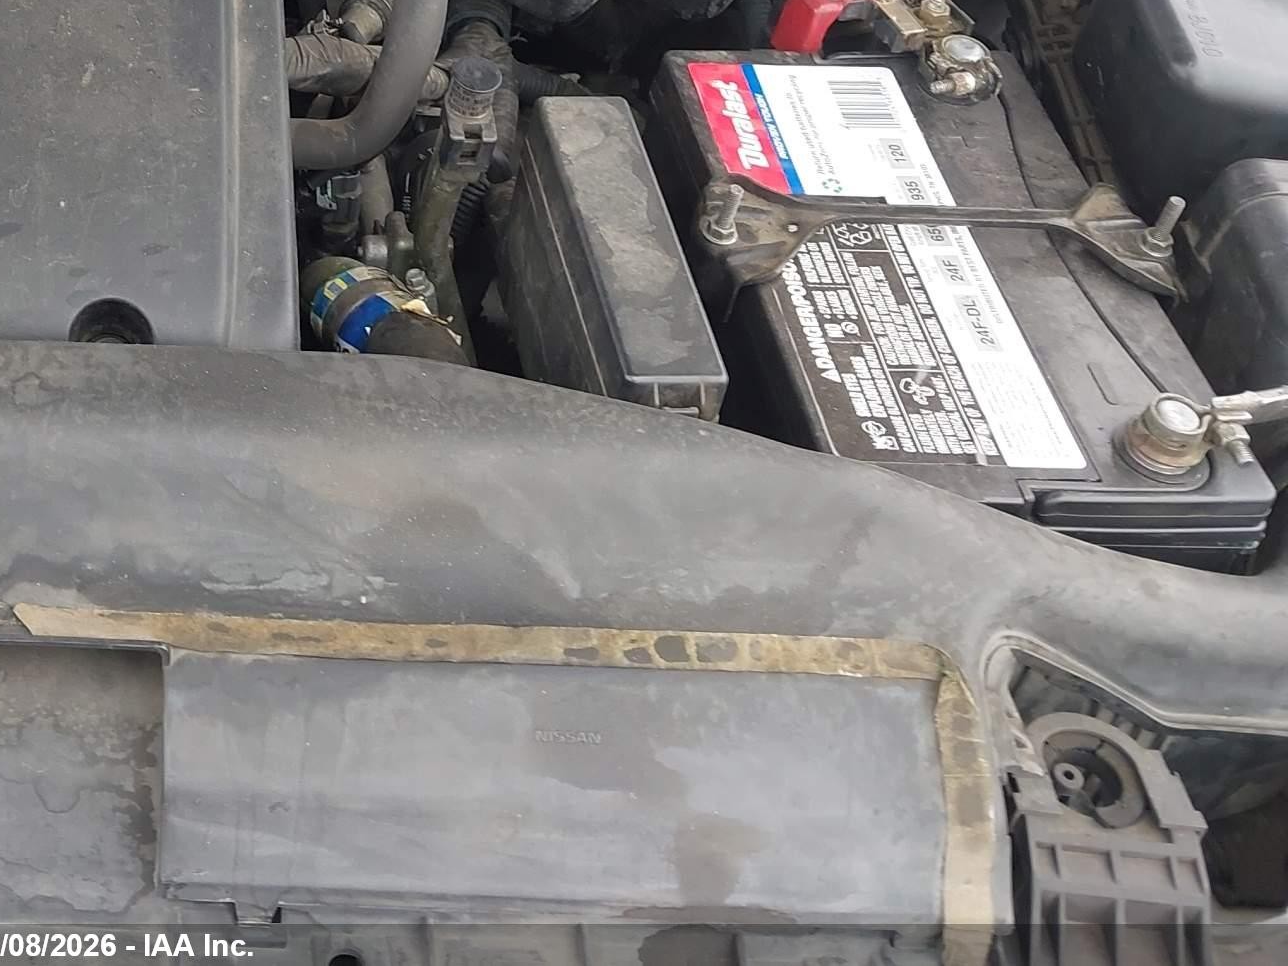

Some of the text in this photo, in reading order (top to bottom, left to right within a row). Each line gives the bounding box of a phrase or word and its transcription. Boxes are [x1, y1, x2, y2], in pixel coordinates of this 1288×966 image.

[713, 81, 767, 167] Duralast
[755, 93, 787, 158] PROVEN TOUGH
[888, 144, 906, 161] 120
[904, 181, 924, 200] 935
[942, 260, 963, 280] 24F
[781, 260, 833, 368] DANGER/POISO
[963, 300, 994, 344] 24F-DL
[824, 323, 843, 337] NO
[535, 730, 601, 745] NISSAN
